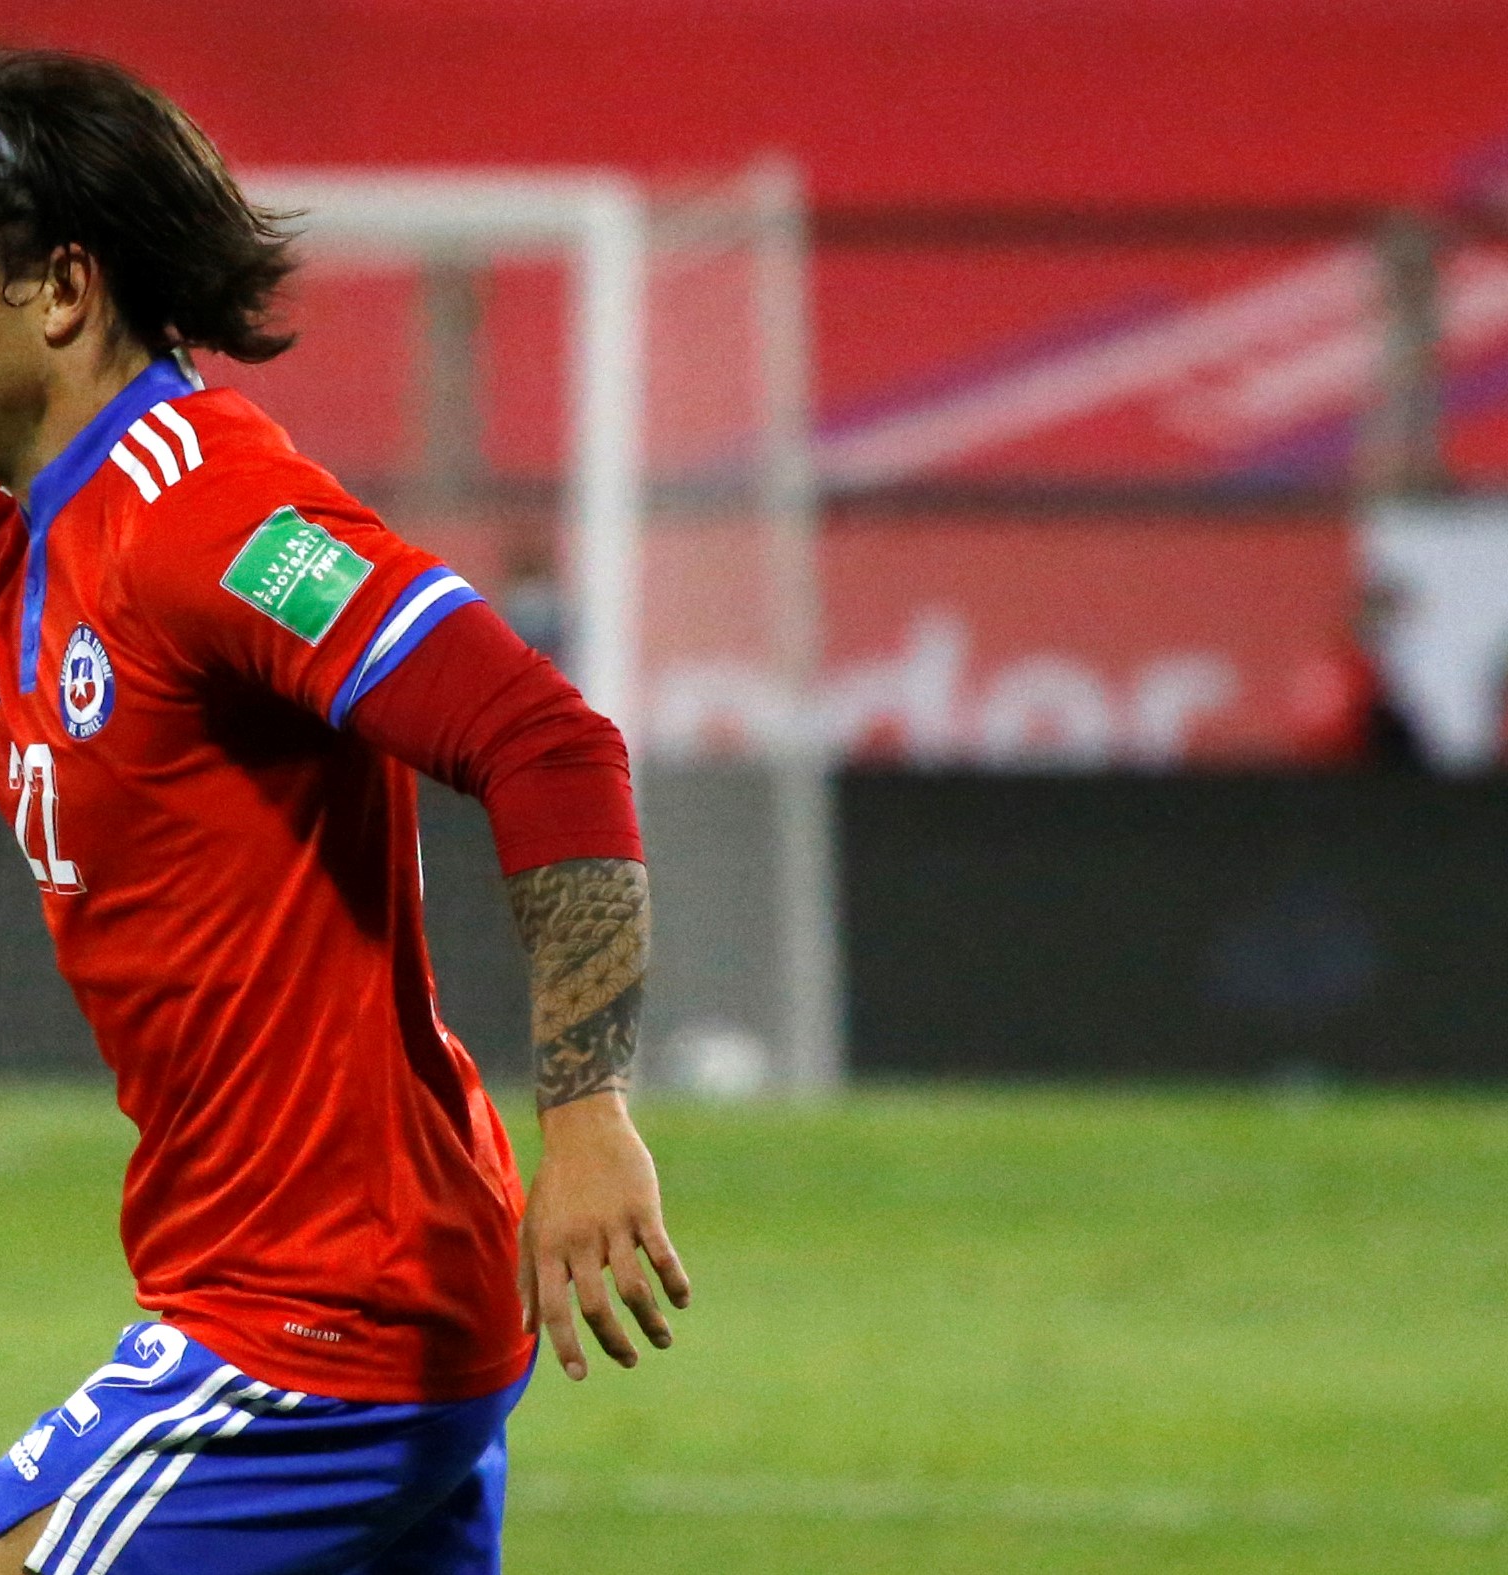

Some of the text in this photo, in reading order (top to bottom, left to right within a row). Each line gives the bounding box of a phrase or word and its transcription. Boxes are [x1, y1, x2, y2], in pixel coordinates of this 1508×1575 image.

[253, 529, 310, 599] LIVING
[263, 534, 320, 606] FOOTBALL
[311, 547, 342, 582] FIFA
[8, 741, 88, 895] 22
[283, 1321, 342, 1342] AEROREADY
[57, 1323, 189, 1437] 2
